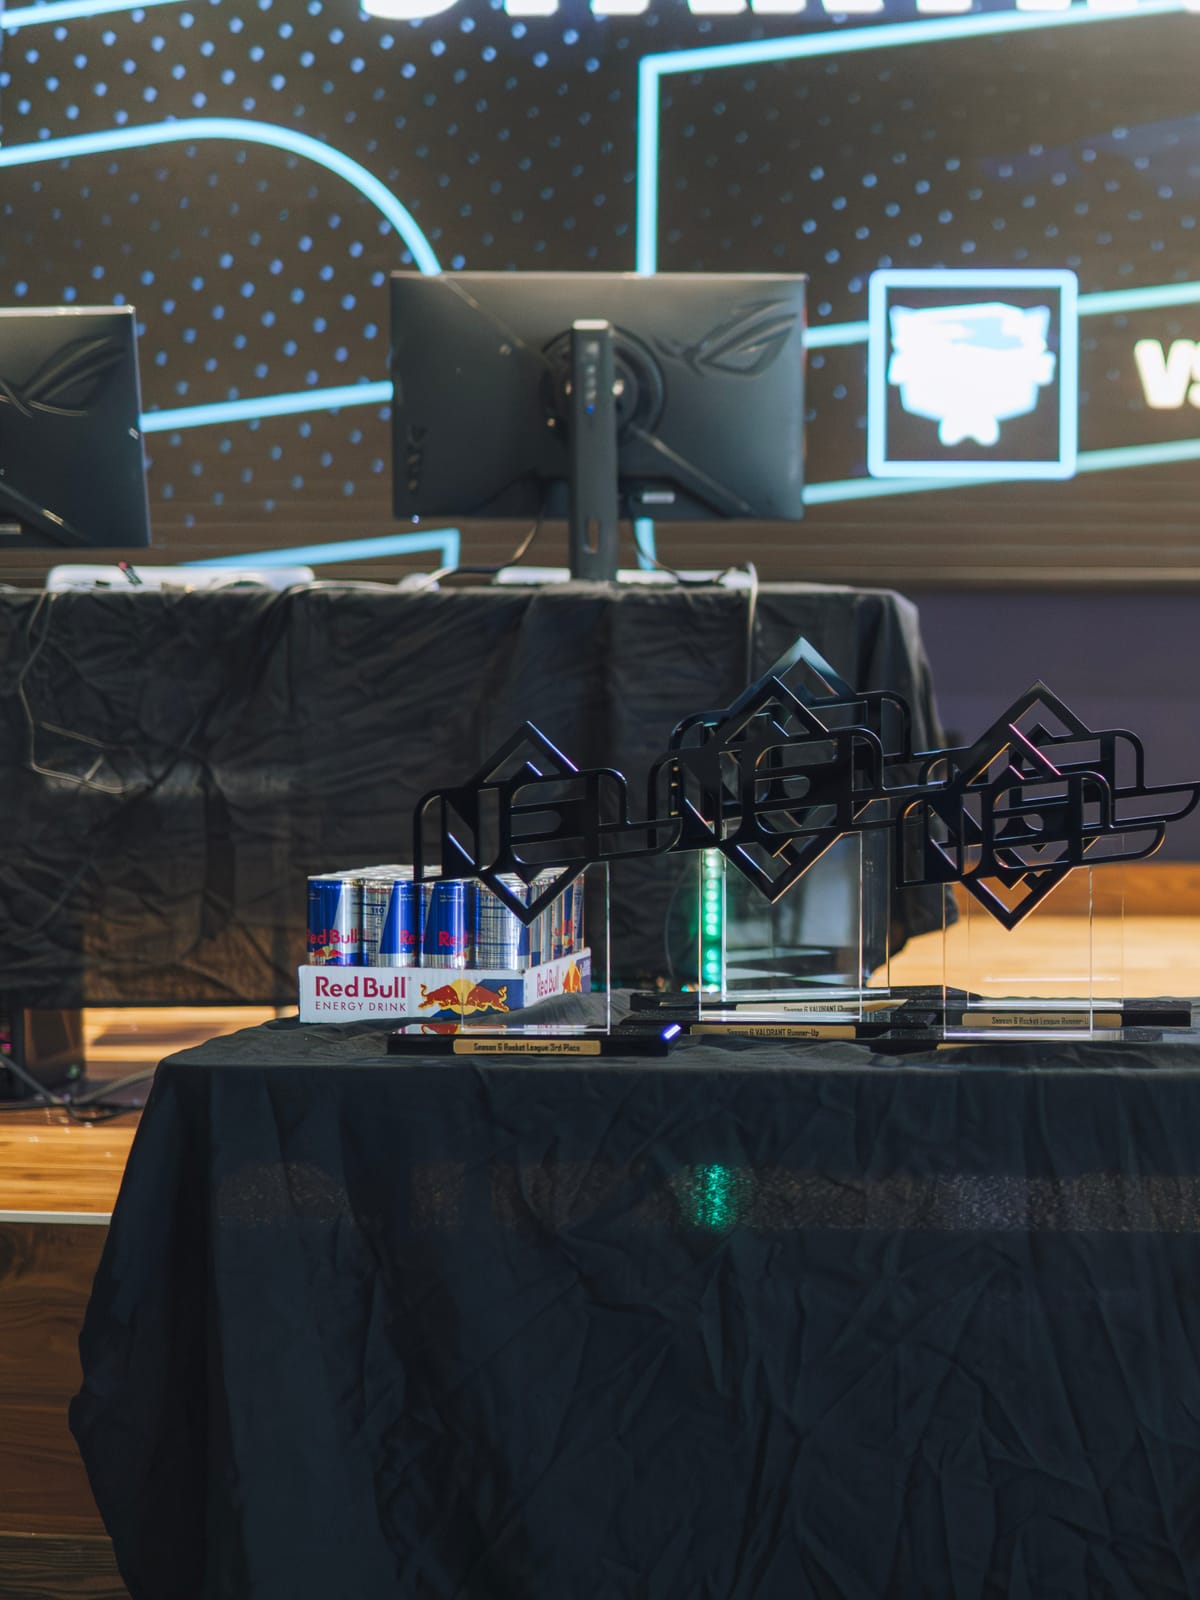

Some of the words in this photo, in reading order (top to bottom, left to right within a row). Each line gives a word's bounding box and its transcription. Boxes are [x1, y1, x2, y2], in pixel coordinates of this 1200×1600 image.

[315, 975, 359, 998] Red
[363, 976, 406, 998] Bull
[315, 1001, 364, 1011] ENERGY
[368, 1002, 407, 1012] DRINK
[755, 1028, 786, 1037] VALORANT
[526, 1042, 548, 1052] League
[563, 1043, 580, 1052] Place
